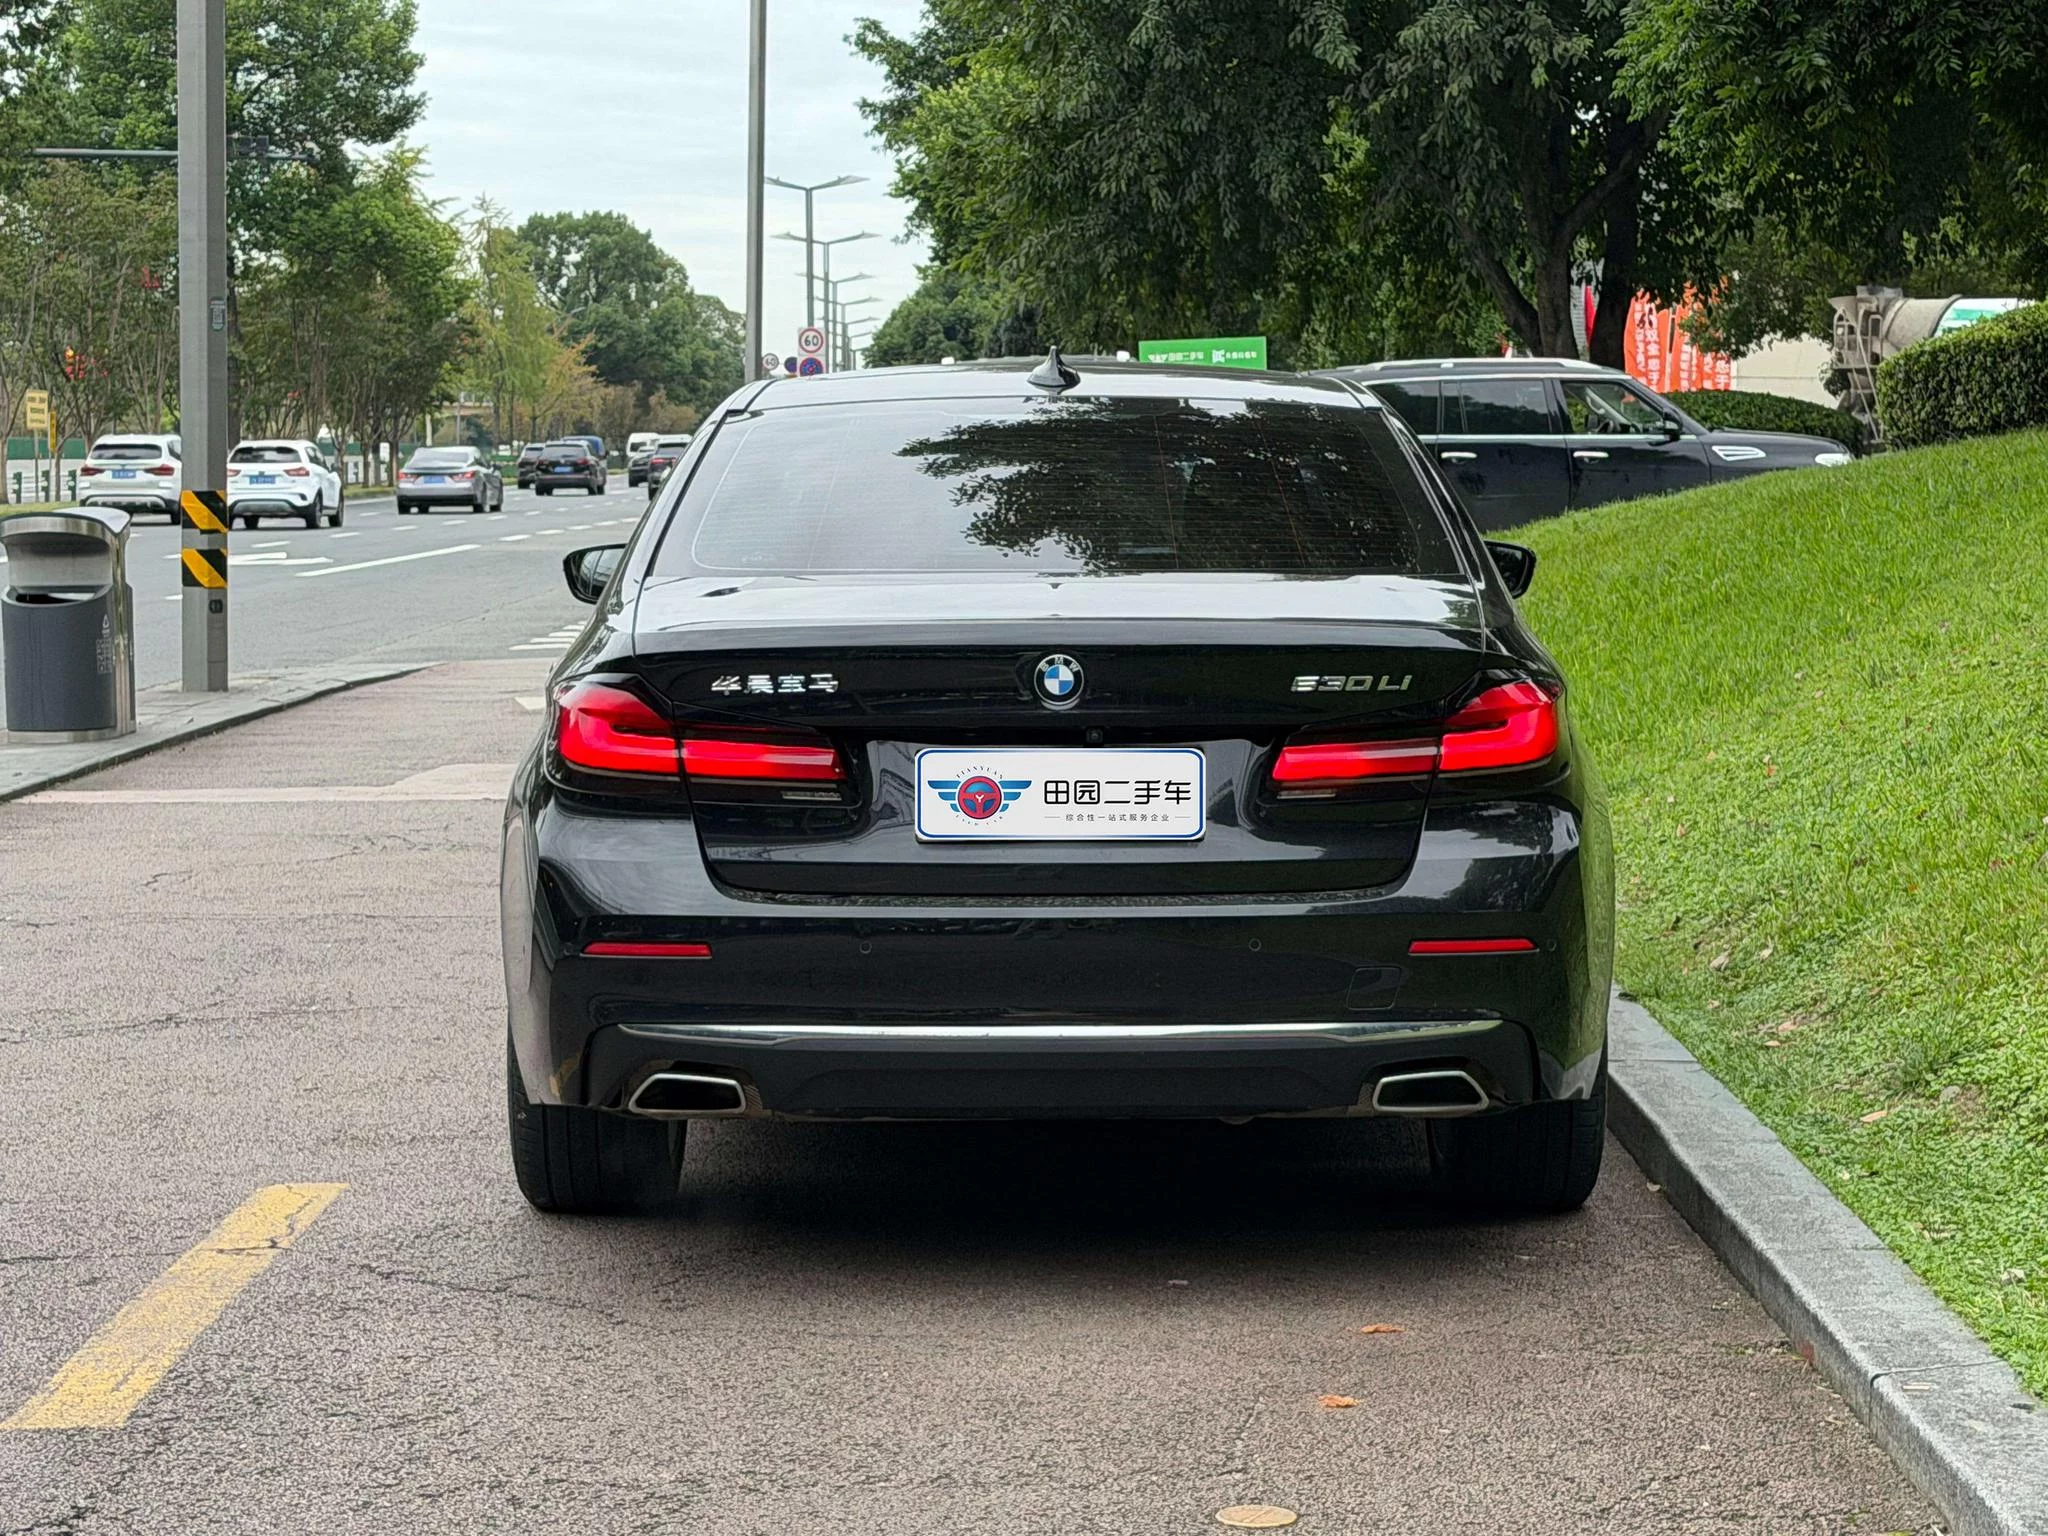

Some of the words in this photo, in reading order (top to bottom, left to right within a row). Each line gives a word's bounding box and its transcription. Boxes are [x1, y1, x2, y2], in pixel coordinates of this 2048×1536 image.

[804, 335, 819, 346] 60
[1039, 655, 1080, 672] BMW
[711, 673, 839, 696] 华晨宝马
[1044, 779, 1192, 805] 田园二手车
[1065, 813, 1170, 823] 综合性一站式服务企业
